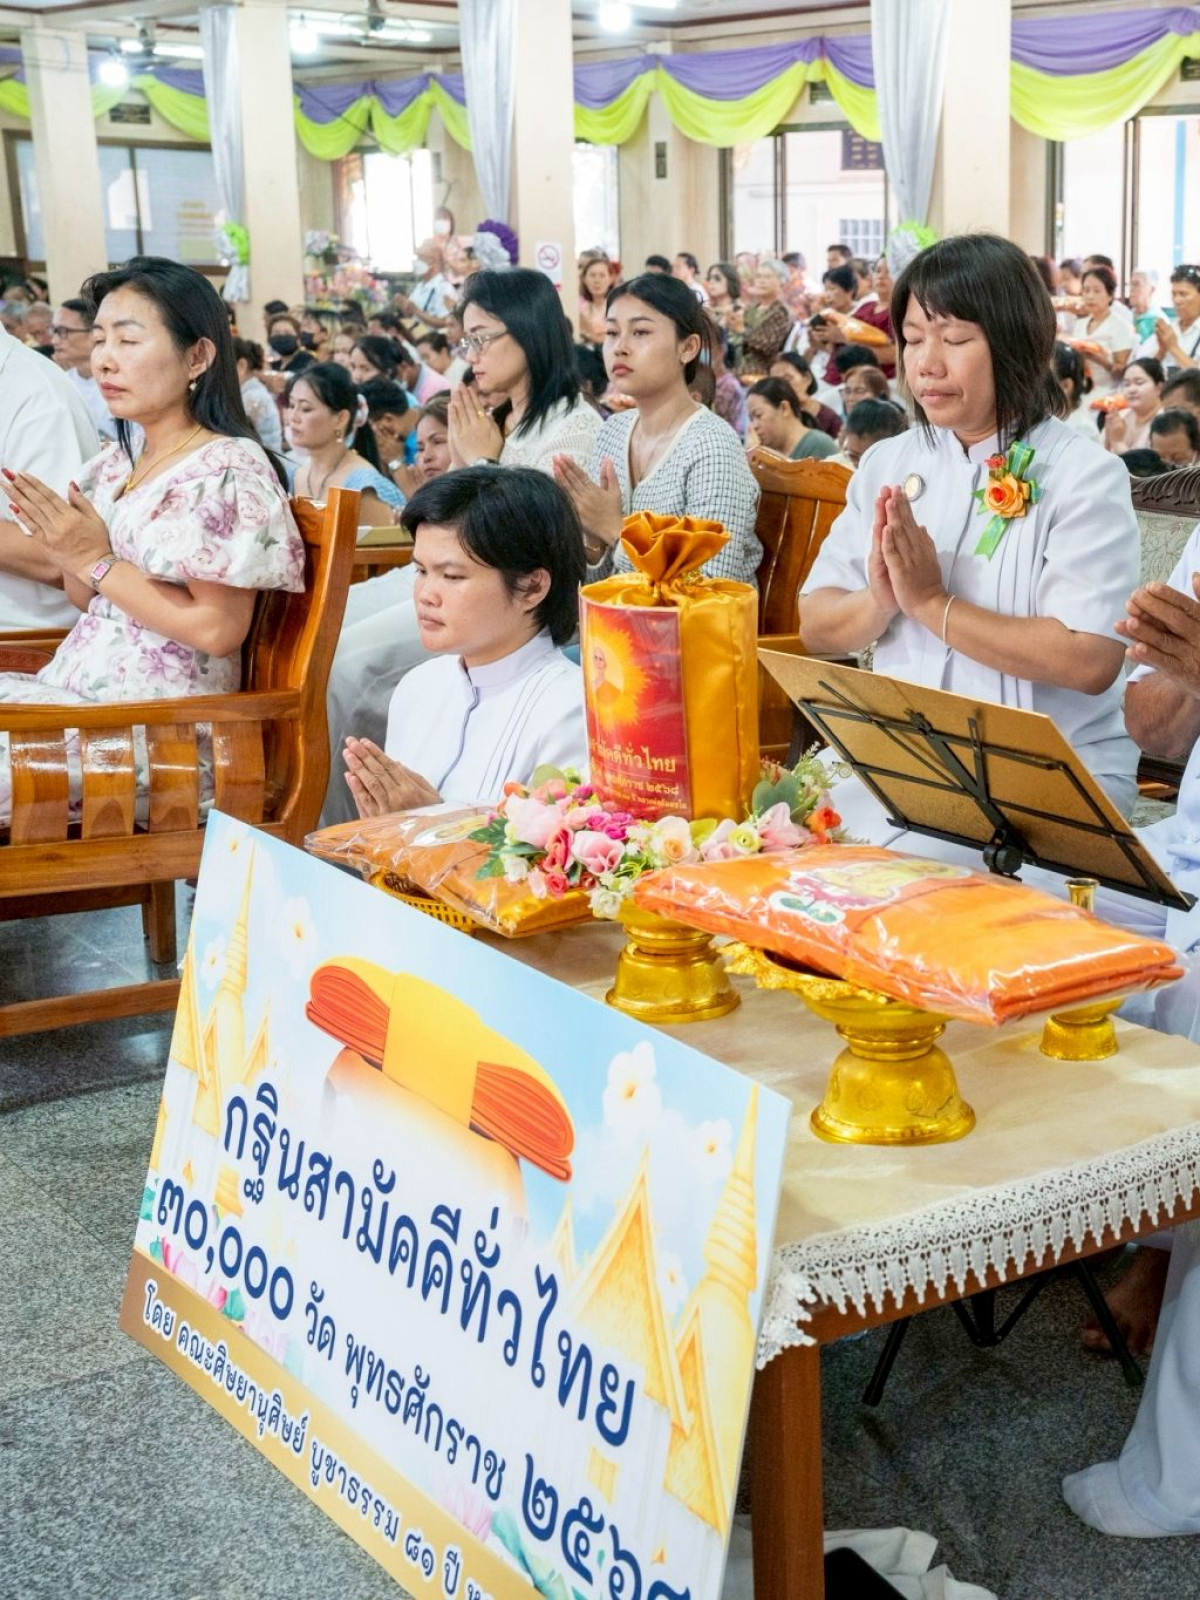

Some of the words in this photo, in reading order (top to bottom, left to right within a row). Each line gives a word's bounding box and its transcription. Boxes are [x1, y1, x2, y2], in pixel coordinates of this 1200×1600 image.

[157, 1178, 294, 1321] ๓๐,๐๐๐
[305, 1281, 337, 1361] วัด
[345, 1333, 506, 1501] พุทธศักราช
[224, 1082, 635, 1447] กฐินสามัคคีทั่วไทย
[143, 1283, 174, 1336] โดย
[177, 1326, 308, 1453] คณะศิษยานุศิษย์
[311, 1441, 399, 1542] บูชาธรรม
[405, 1533, 435, 1577] ๘๑
[445, 1550, 460, 1595] ปี
